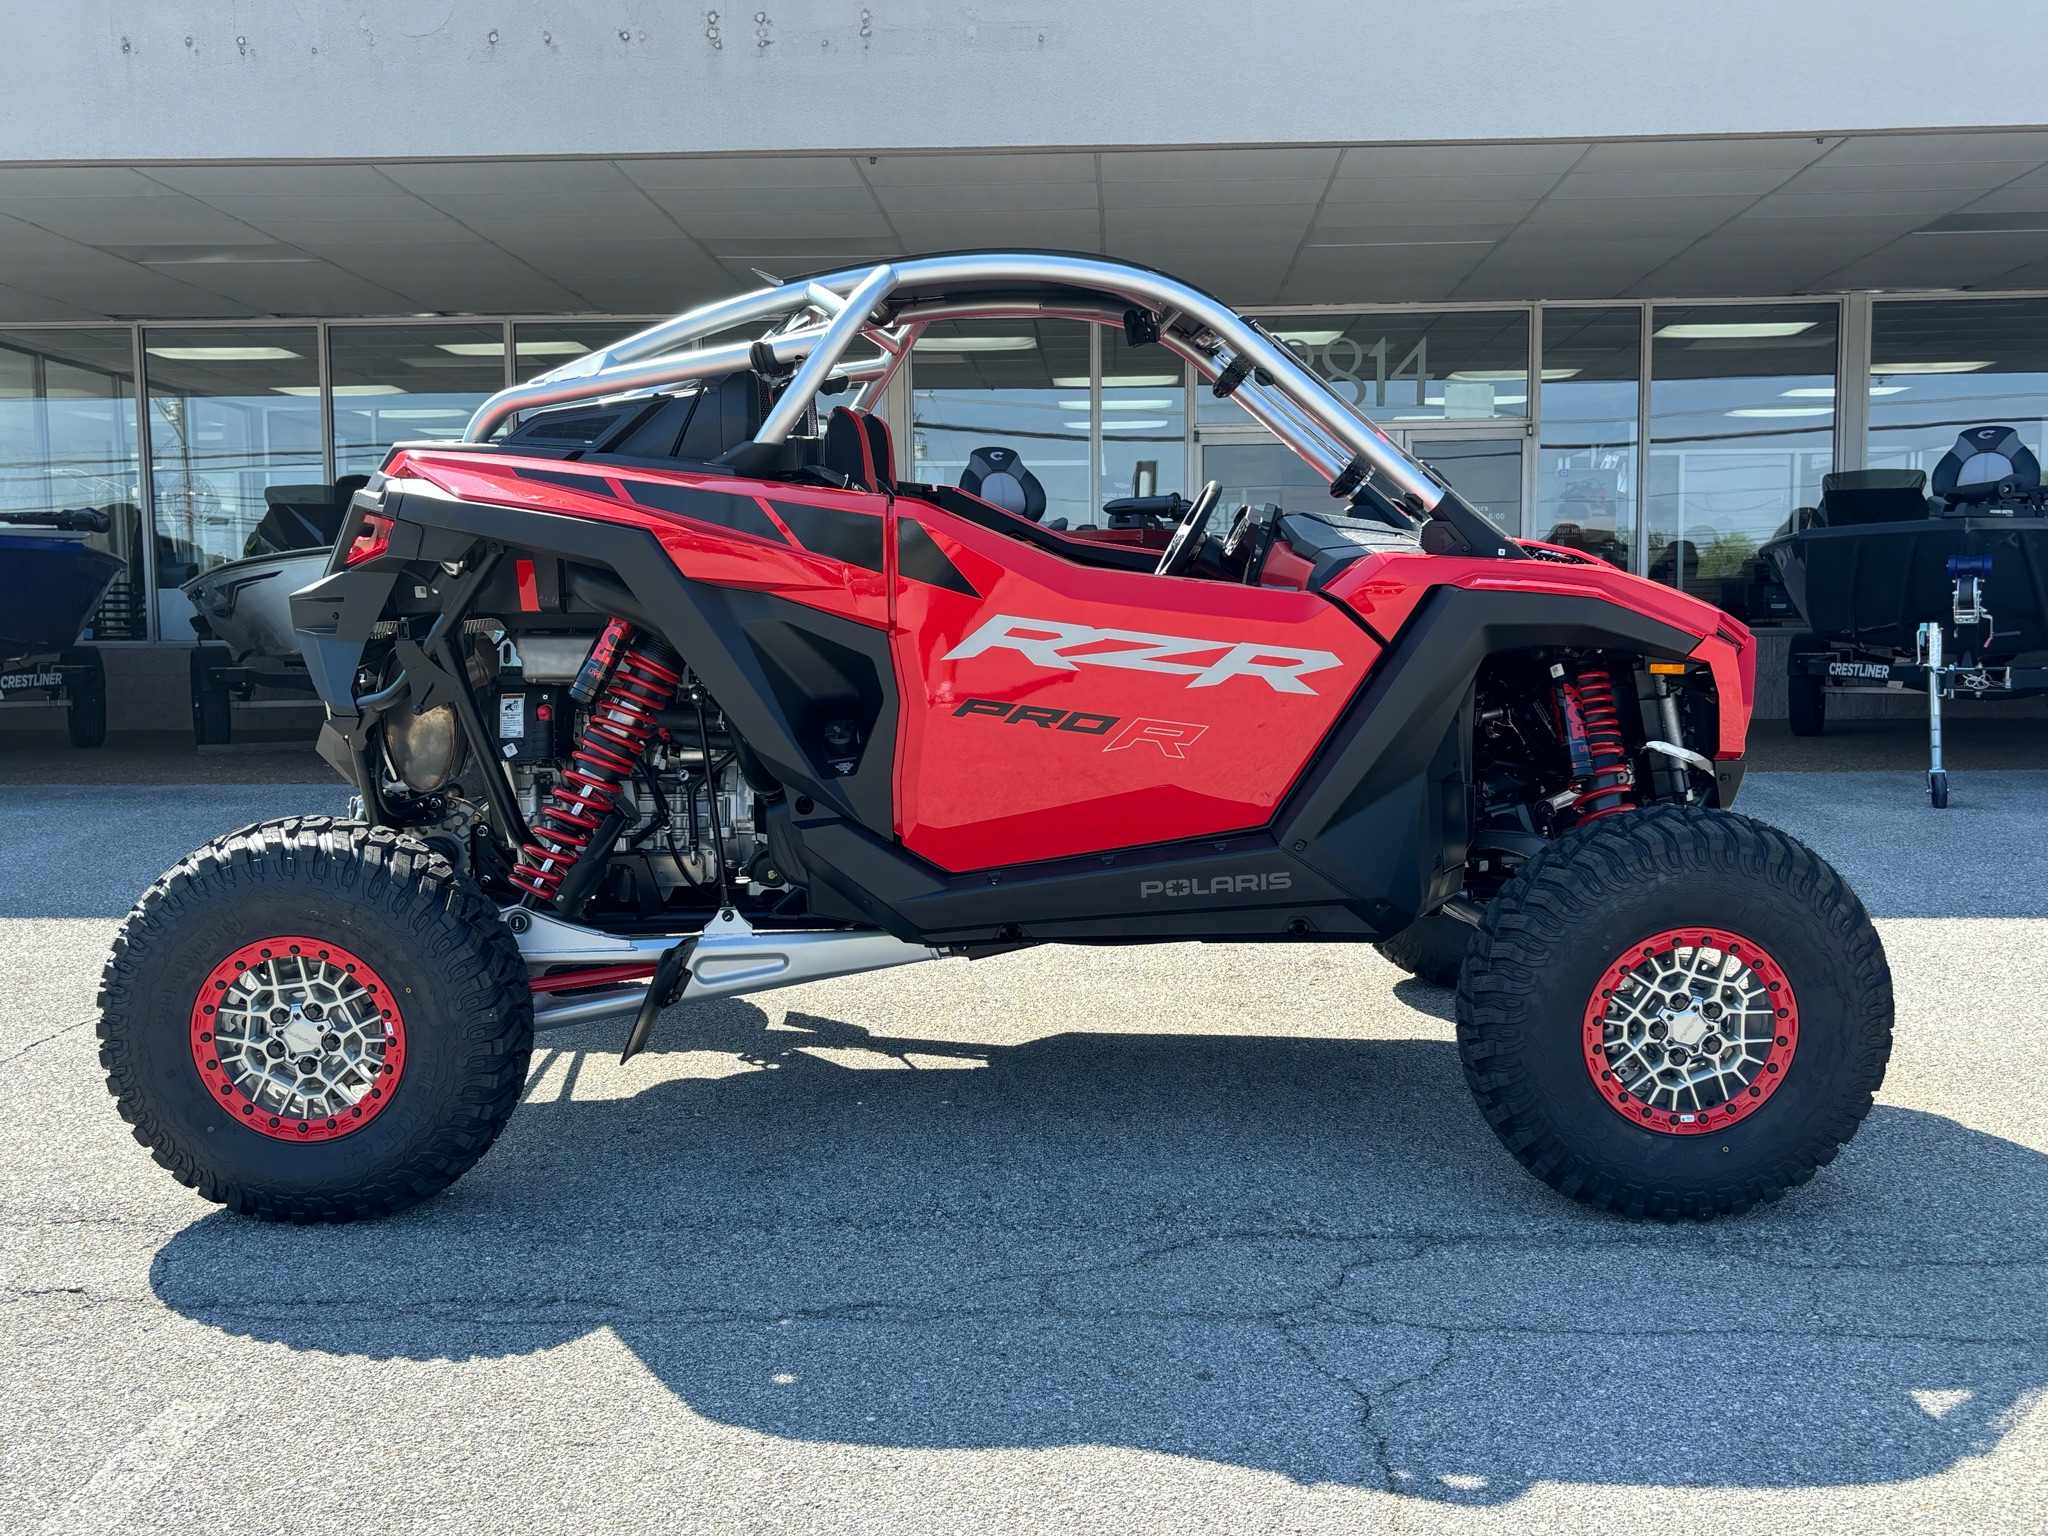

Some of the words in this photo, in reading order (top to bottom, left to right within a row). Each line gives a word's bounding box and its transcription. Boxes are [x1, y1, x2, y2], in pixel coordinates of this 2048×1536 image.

[1488, 512, 1505, 520] 6:00
[941, 614, 1344, 695] RZR
[0, 673, 63, 689] CRESTLINER
[1829, 661, 1890, 679] CRESTLINER
[951, 698, 1121, 735] PRO
[1103, 716, 1209, 759] R
[1140, 871, 1292, 898] POLARIS
